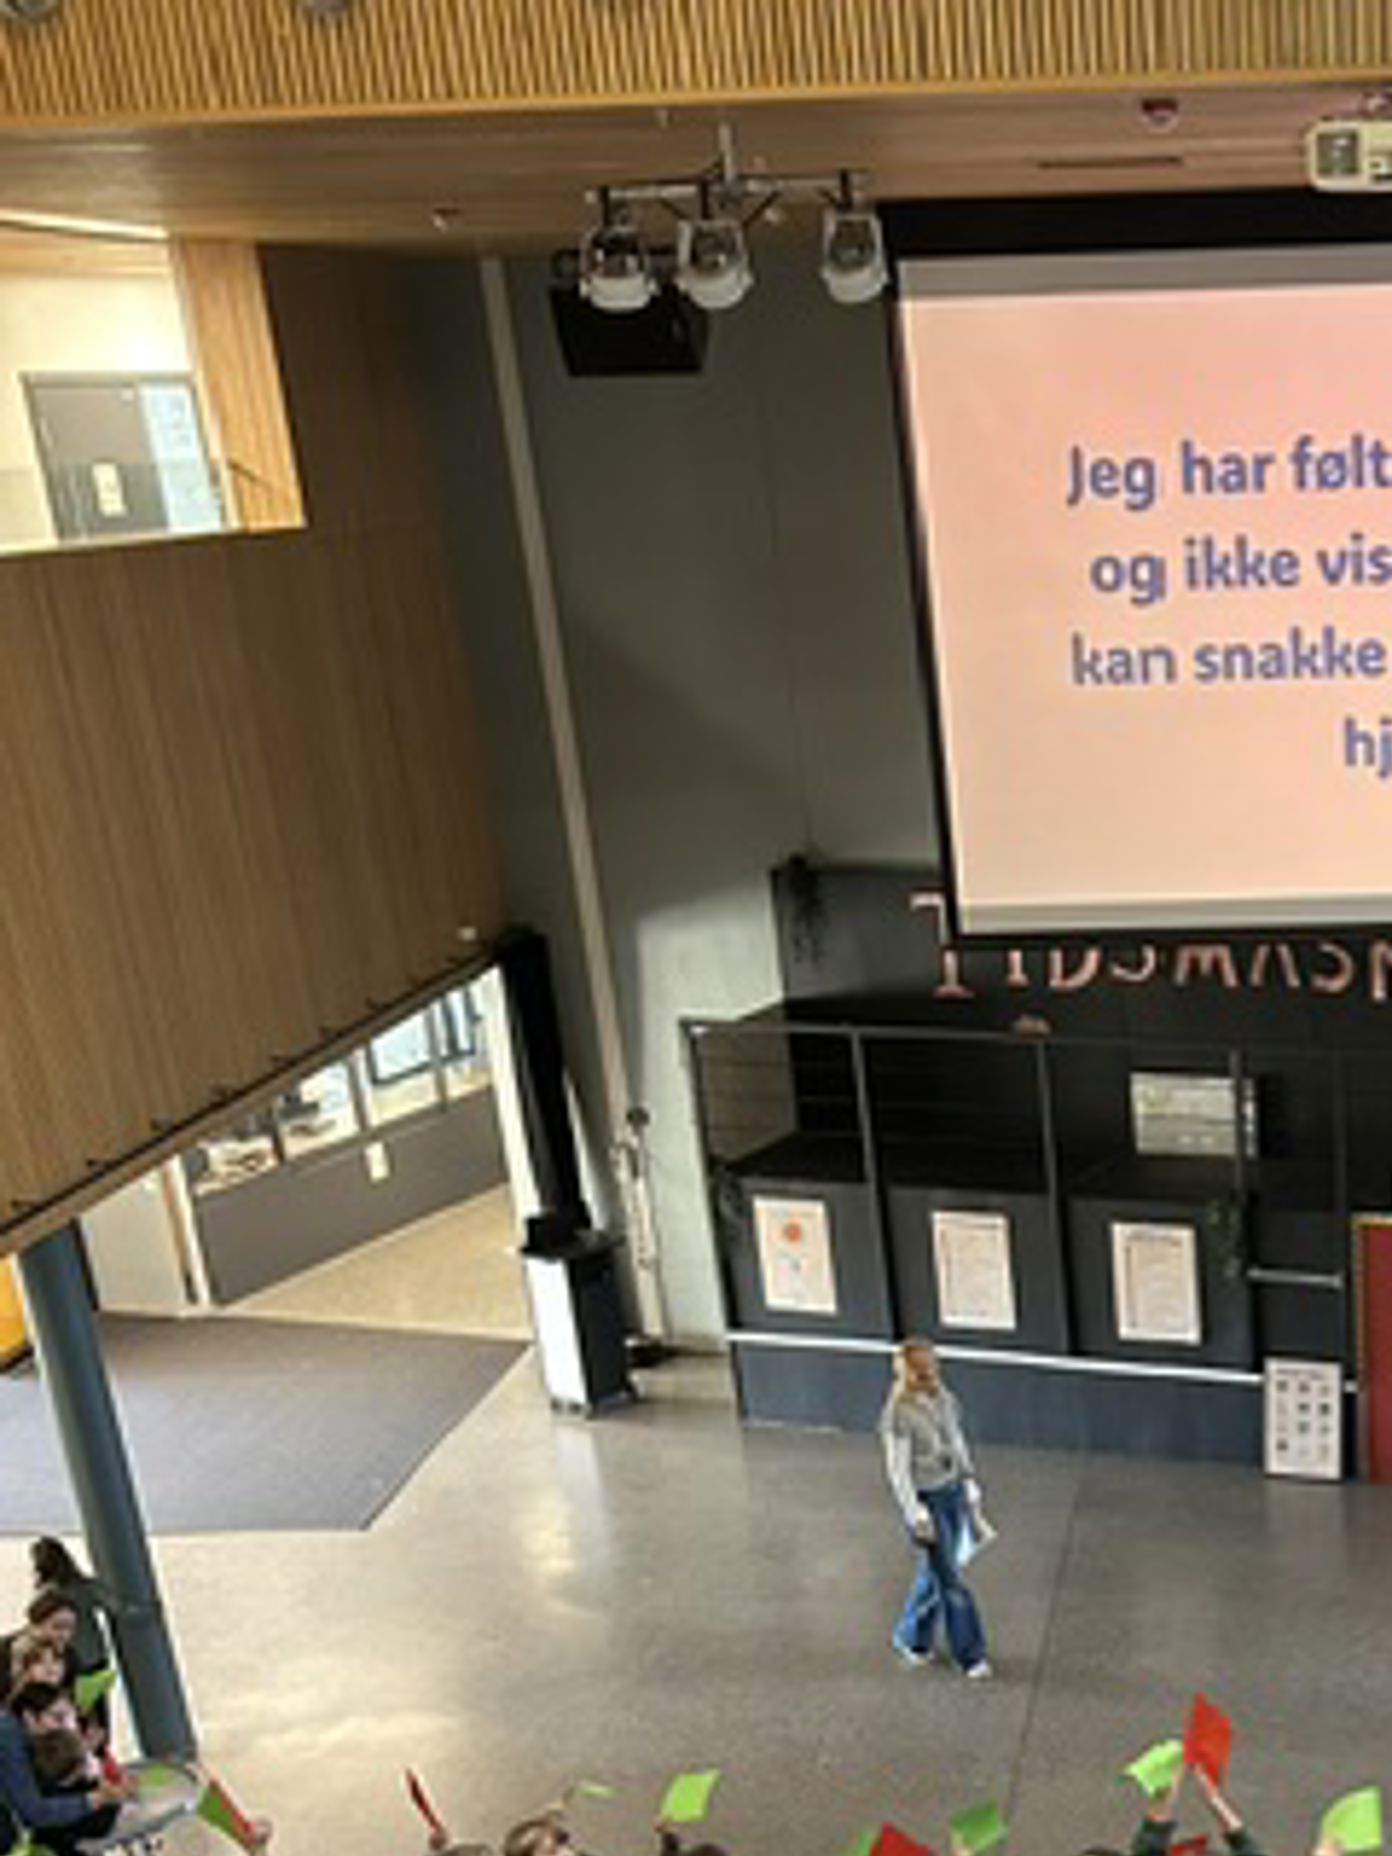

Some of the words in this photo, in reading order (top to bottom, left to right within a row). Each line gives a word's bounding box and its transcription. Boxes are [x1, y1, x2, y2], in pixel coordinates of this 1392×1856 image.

[1066, 444, 1157, 514] Jeg
[1180, 438, 1277, 496] har
[1089, 553, 1168, 607] og
[1183, 534, 1300, 592] ikke
[1070, 637, 1178, 687] kan
[1193, 625, 1387, 685] snakke
